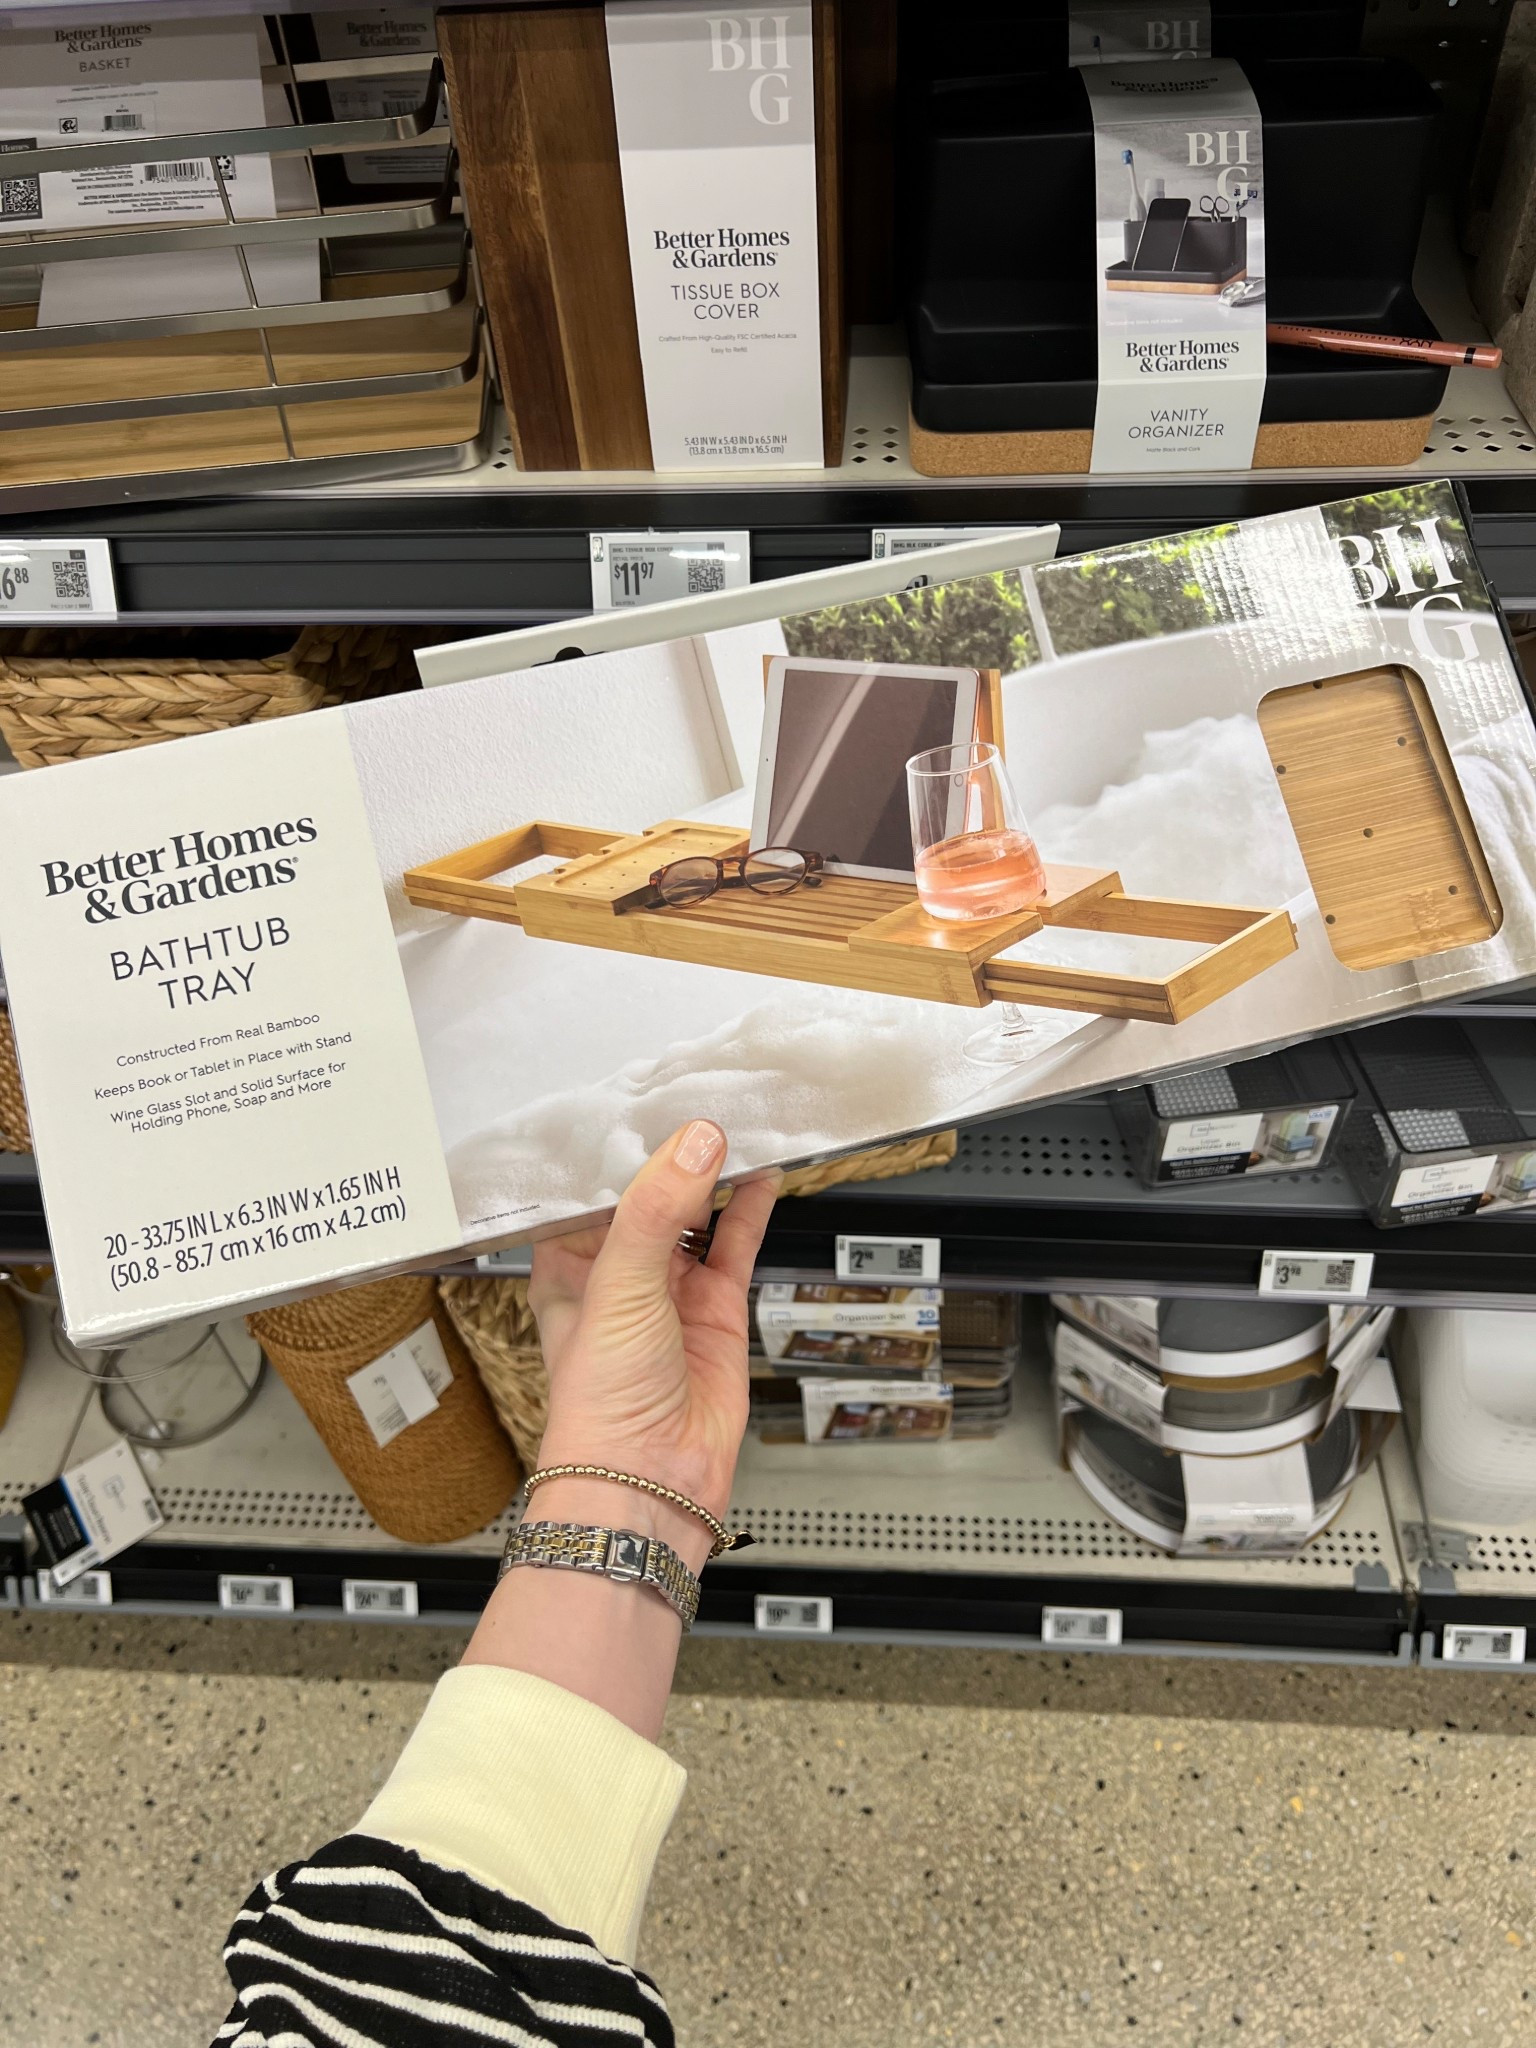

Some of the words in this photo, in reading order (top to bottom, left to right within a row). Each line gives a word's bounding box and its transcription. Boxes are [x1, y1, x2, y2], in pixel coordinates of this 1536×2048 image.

[54, 29, 98, 42] Better
[100, 23, 152, 38] Homes
[81, 36, 143, 52] Gardens
[706, 16, 792, 72] BH
[1146, 20, 1200, 50] BH
[79, 57, 131, 73] BASKET
[749, 72, 792, 126] G
[1185, 130, 1251, 167] BH
[1217, 166, 1250, 202] G
[653, 230, 715, 249] Better
[717, 228, 790, 247] Homes
[672, 249, 690, 269] &
[691, 248, 776, 268] Gardens
[670, 283, 734, 300] TISSUE
[741, 282, 780, 299] BOX
[694, 303, 760, 320] COVER
[1126, 342, 1177, 358] Better
[1179, 340, 1240, 355] Homes
[1139, 357, 1154, 373] &
[1155, 355, 1228, 373] Gardens
[1128, 423, 1224, 439] ORGANIZER
[1150, 408, 1209, 423] VANITY
[1408, 593, 1480, 662] G
[41, 847, 166, 897] Better
[169, 817, 317, 870] Homes
[85, 888, 121, 925] &
[110, 917, 290, 981] BATHTUB
[158, 962, 256, 1009] TRAY
[117, 1040, 197, 1067] Constructed
[199, 1034, 232, 1048] From
[235, 1024, 264, 1040] Real
[266, 1014, 320, 1033] Bamboo
[94, 1083, 135, 1100] Keeps
[138, 1073, 172, 1090] Book
[174, 1071, 188, 1082] or
[190, 1059, 231, 1077] Tablet
[233, 1058, 245, 1068] in
[248, 1049, 283, 1064] Place
[286, 1042, 313, 1055] with
[315, 1032, 352, 1049] Stand
[110, 1108, 144, 1124] Wine
[146, 1100, 182, 1116] Glass
[184, 1091, 211, 1107] Slot
[213, 1085, 238, 1100] and
[241, 1077, 273, 1094] Solid
[276, 1067, 325, 1085] Surface
[328, 1062, 346, 1073] for
[131, 1114, 183, 1133] Holding
[186, 1103, 231, 1120] Phone,
[234, 1094, 267, 1109] Soap
[270, 1086, 294, 1100] and
[298, 1079, 332, 1094] More
[104, 1233, 127, 1259] 20
[141, 1219, 185, 1250] 33.75
[187, 1213, 207, 1239] IN
[209, 1210, 223, 1233] L
[223, 1212, 236, 1230] x
[238, 1200, 265, 1226] 6.3
[267, 1193, 287, 1220] IN
[289, 1188, 309, 1213] W
[313, 1190, 326, 1209] x
[325, 1176, 362, 1204] 1.65
[363, 1170, 384, 1195] IN
[386, 1165, 401, 1190] H
[111, 1257, 159, 1292] (50.8
[175, 1242, 213, 1272] 85.7
[220, 1239, 249, 1261] cm
[252, 1235, 265, 1254] x
[265, 1225, 288, 1250] 16
[292, 1221, 321, 1243] cm
[324, 1217, 337, 1237] x
[339, 1205, 368, 1231] 4.2
[371, 1195, 406, 1224] cm)
